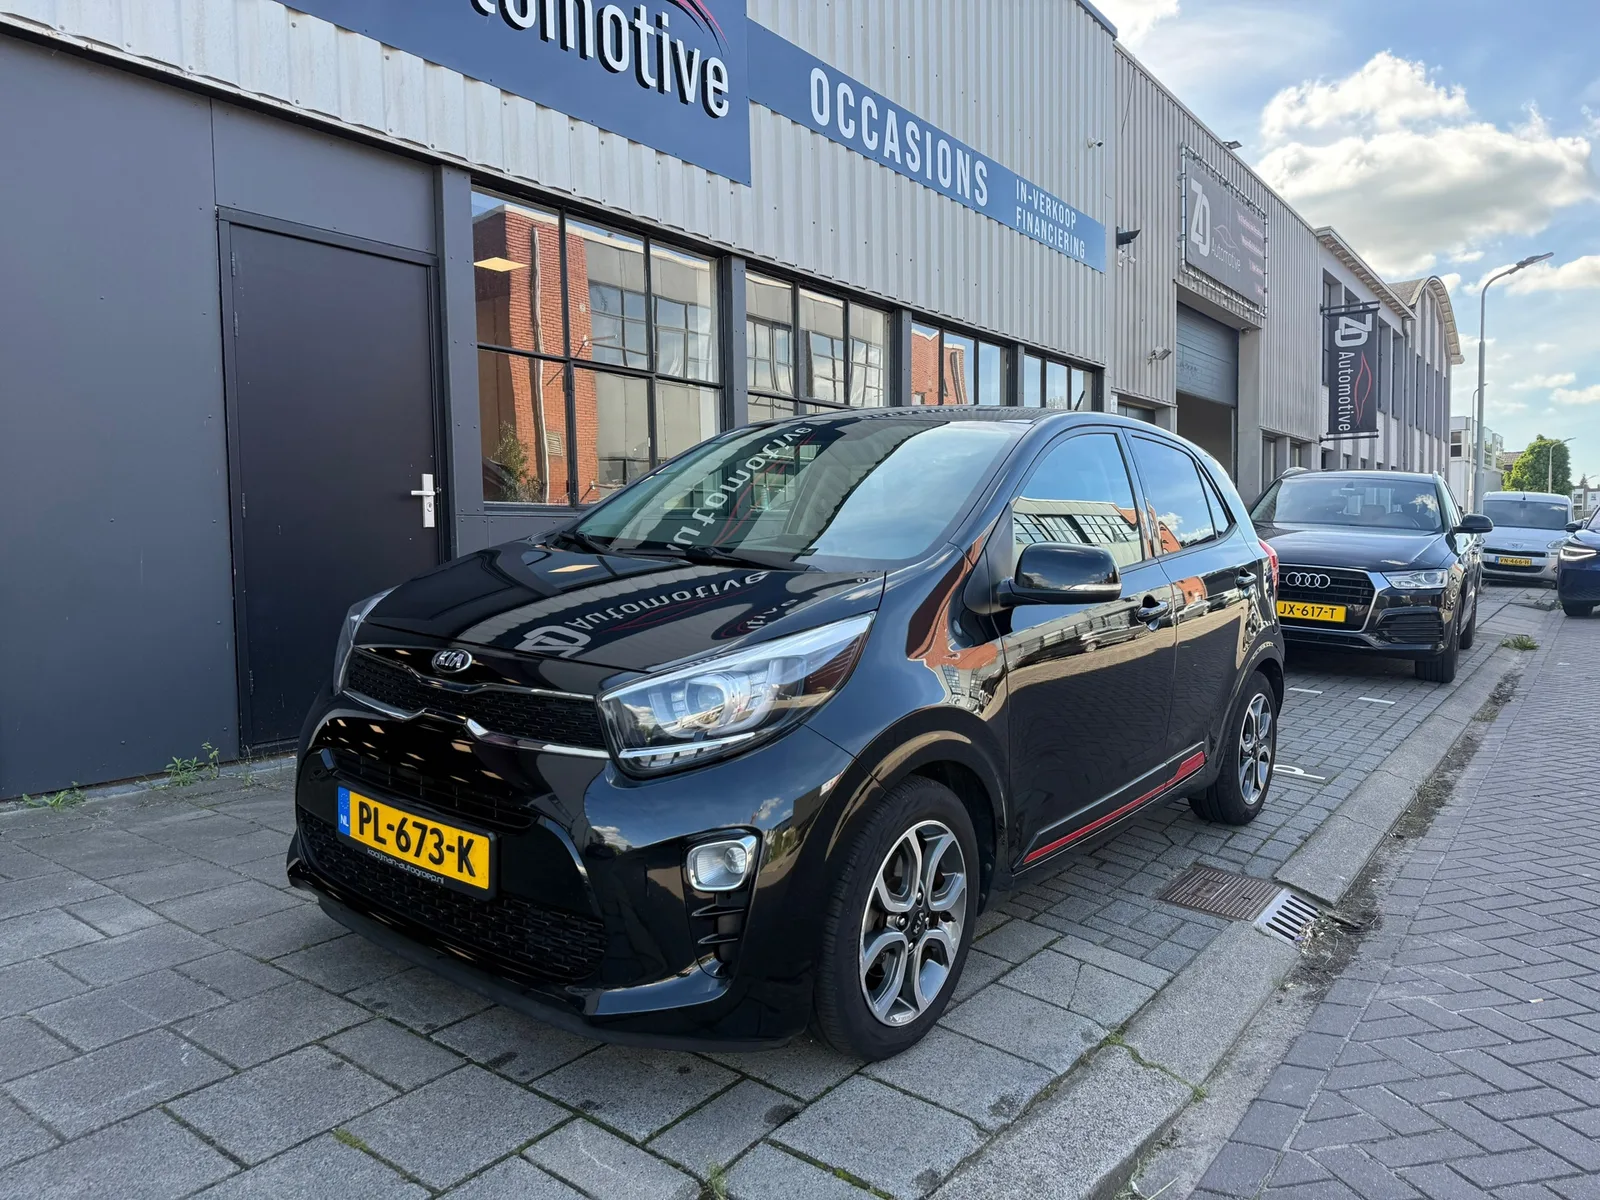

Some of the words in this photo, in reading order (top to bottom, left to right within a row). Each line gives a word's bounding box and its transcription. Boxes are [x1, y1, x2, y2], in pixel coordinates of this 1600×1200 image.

[476, 0, 729, 118] motive
[810, 67, 988, 207] OCCASIONS
[1016, 179, 1076, 226] IN-VERKOOP
[1016, 206, 1085, 260] FINANCIERING
[1338, 351, 1355, 431] Automotive
[1280, 604, 1337, 619] JX-617-T
[436, 651, 464, 668] KIA
[340, 813, 349, 827] NL
[358, 801, 476, 877] PL-673-K
